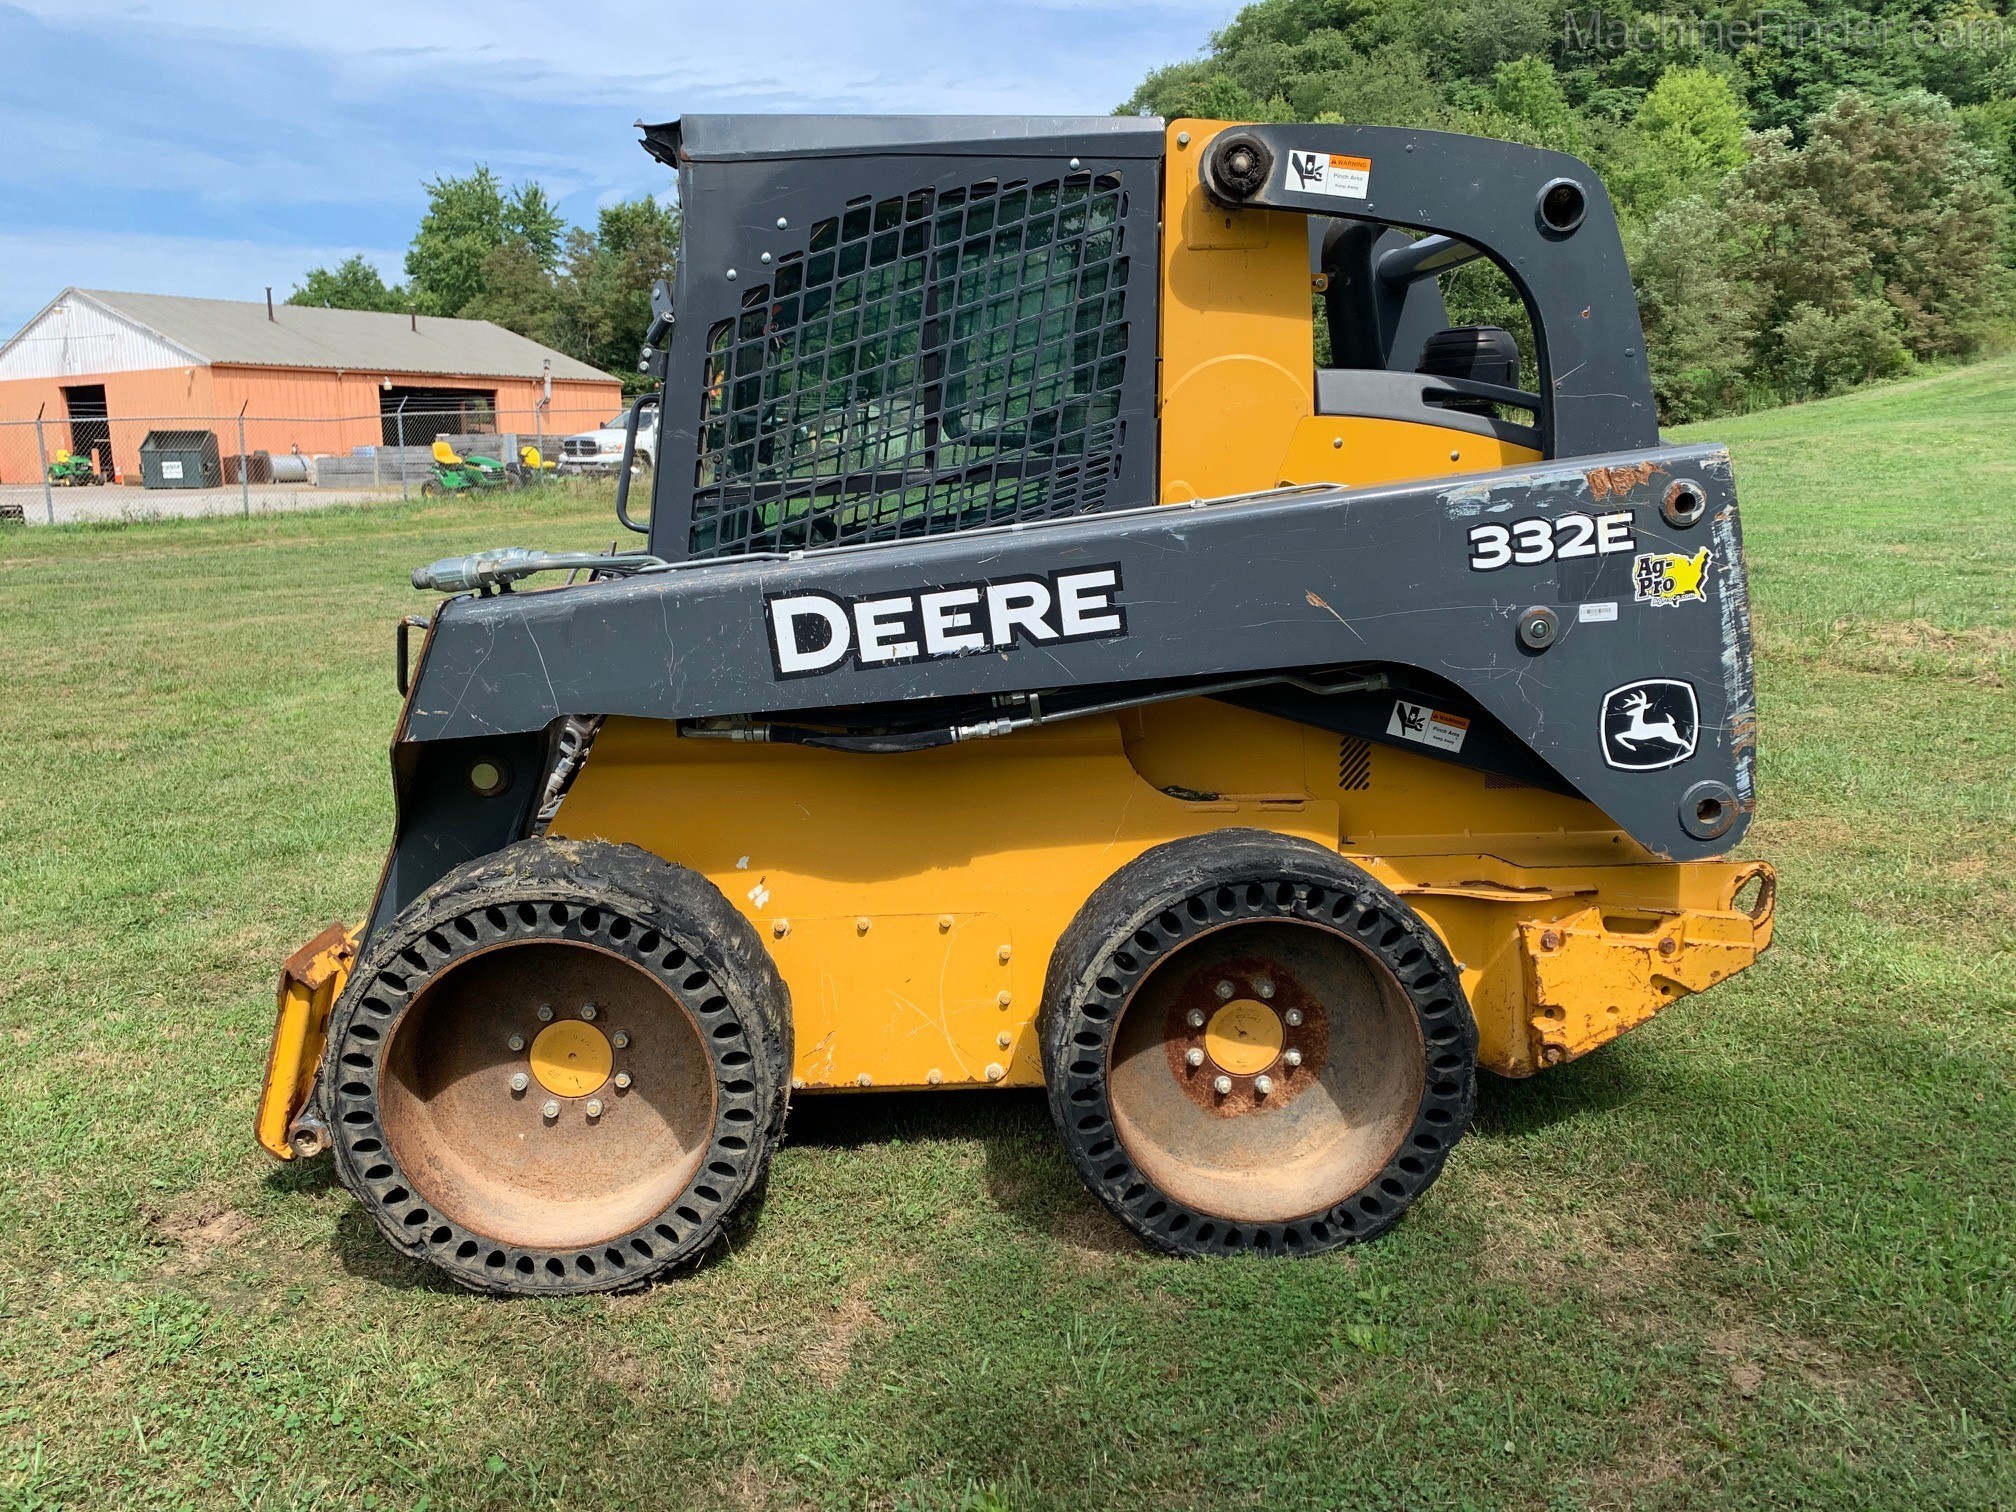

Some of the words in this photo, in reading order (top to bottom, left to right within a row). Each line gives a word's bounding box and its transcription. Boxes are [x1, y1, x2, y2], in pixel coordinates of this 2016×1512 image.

[1338, 160, 1367, 168] WARNING
[1469, 511, 1635, 570] 332E
[1637, 557, 1673, 579] Ag-
[1638, 577, 1675, 597] Pro
[770, 569, 1121, 674] DEERE
[1433, 726, 1447, 734] Pinch
[1439, 715, 1466, 727] WARNING
